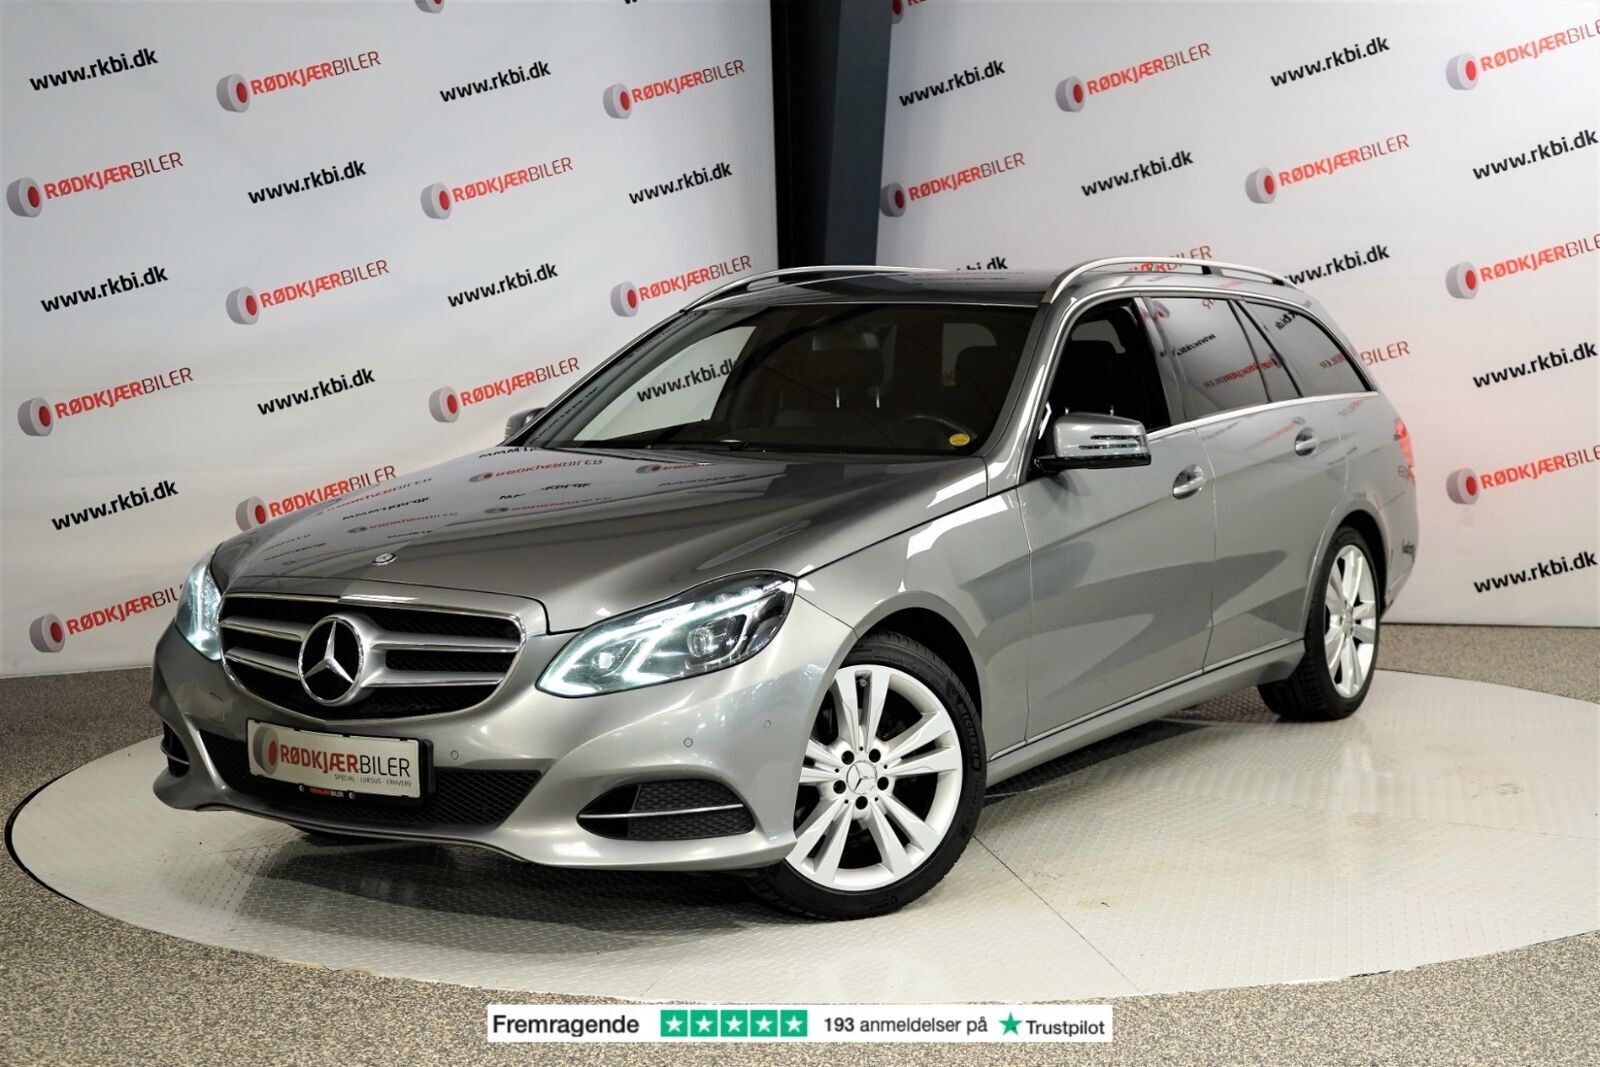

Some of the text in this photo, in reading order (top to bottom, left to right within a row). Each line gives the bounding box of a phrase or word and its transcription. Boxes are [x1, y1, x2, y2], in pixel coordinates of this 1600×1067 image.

[29, 48, 158, 91] www.rkbi.dk
[250, 51, 381, 95] RØDKJÆRBILER
[440, 61, 551, 102] www.rkbi.dk
[631, 60, 745, 102] RØDKJÆRBILER
[898, 61, 1005, 107] www.rkbi.dk
[1087, 43, 1210, 95] RØDKJÆRBILER
[1270, 37, 1390, 87] www.rkbi.dk
[44, 152, 183, 199] RØDKJÆRBILER
[908, 153, 1024, 201] RØDKJÆRBILER
[1081, 151, 1193, 196] www.rkbi.dk
[1278, 134, 1409, 186] RØDKJÆRBILER
[1472, 130, 1598, 179] www.rkbi.dk
[248, 160, 366, 204] www.rkbi.dk
[452, 157, 573, 202] RØDKJÆRBILER
[629, 162, 733, 204] www.rkbi.dk
[259, 260, 389, 308] RØDKJÆRBILER
[448, 263, 558, 307] www.rkbi.dk
[639, 254, 753, 302] RØDKJÆRBILER
[1284, 245, 1390, 285] ww.rkbi.dk
[40, 266, 168, 312] www.rkbi.dk
[460, 357, 580, 407] RØDKJÆRBILER
[1473, 342, 1598, 388] www.rkbi.dk
[55, 368, 193, 419] RØDKJÆRBILER
[257, 368, 375, 415] www.rkbi.dk
[51, 480, 178, 530] www.rkbi.dk
[1473, 551, 1598, 593] www.rkbi.dk
[280, 744, 411, 778] RØDKJÆRBILER
